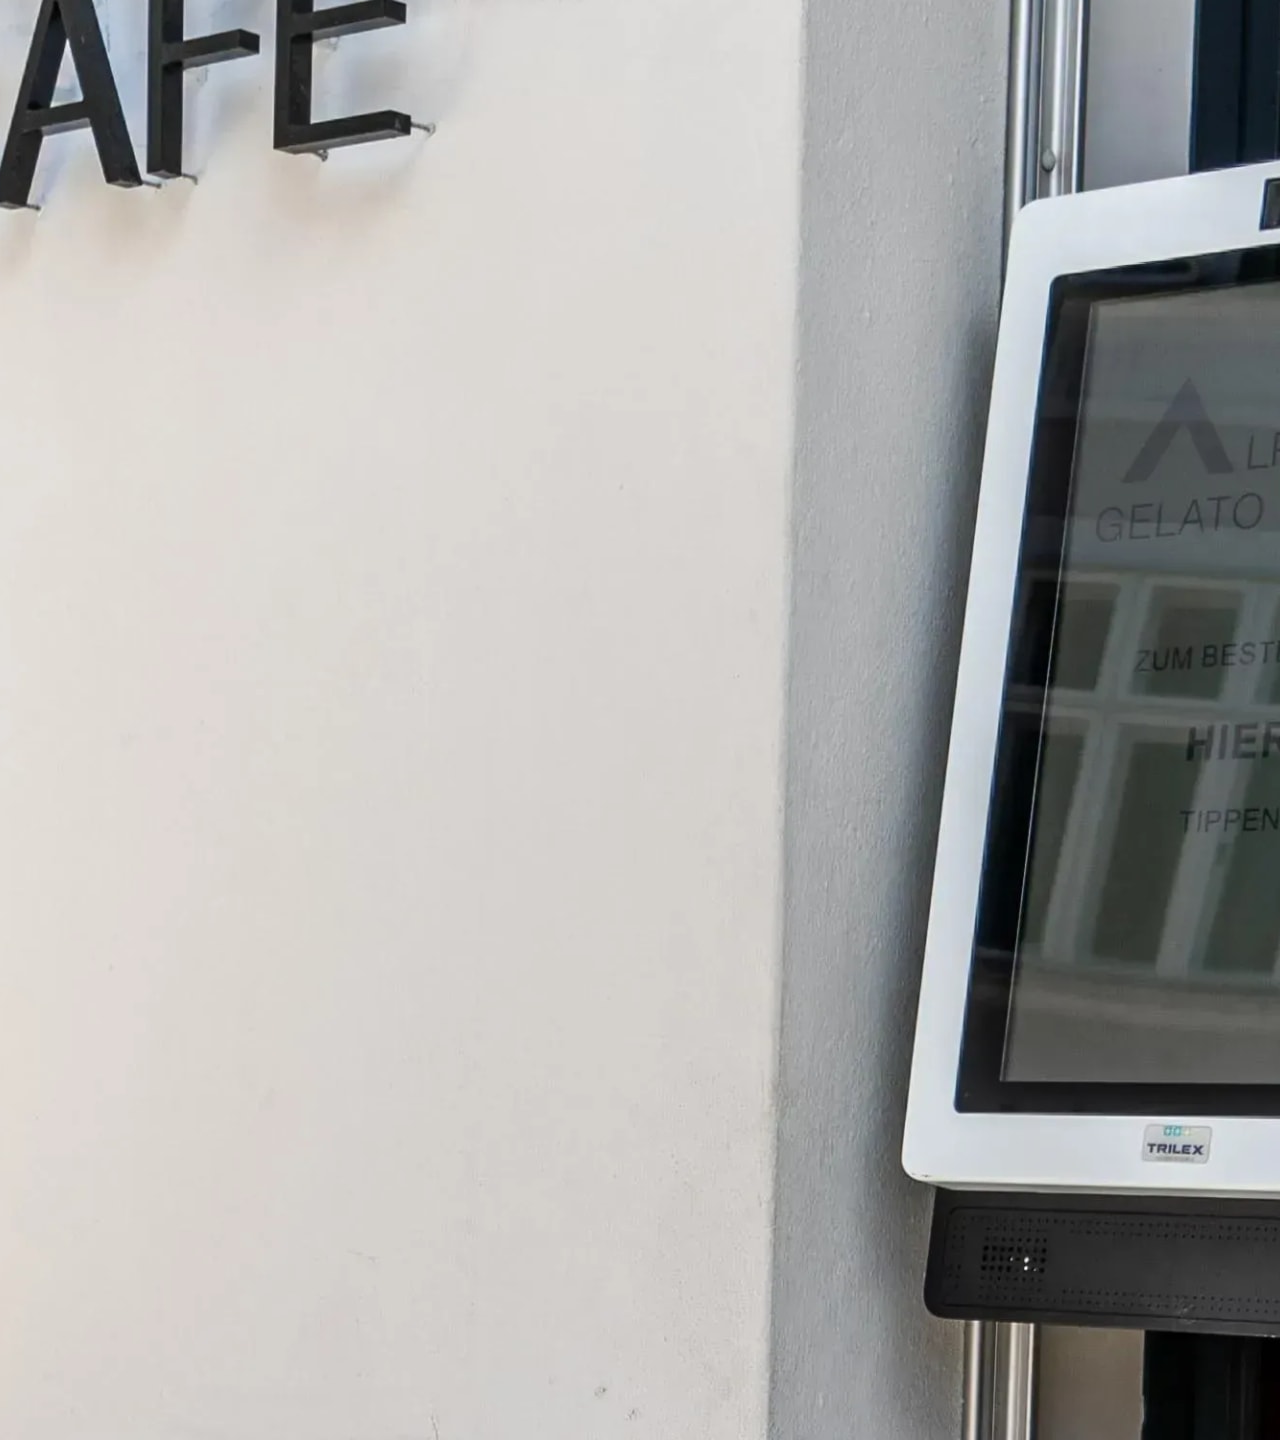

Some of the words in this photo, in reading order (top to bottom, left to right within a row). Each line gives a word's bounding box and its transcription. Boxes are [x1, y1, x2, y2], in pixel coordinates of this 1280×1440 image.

[1095, 492, 1264, 543] GELATO
[1134, 642, 1193, 672] ZUM
[1179, 808, 1280, 834] TIPPEN
[1147, 1143, 1205, 1155] TRILEX
